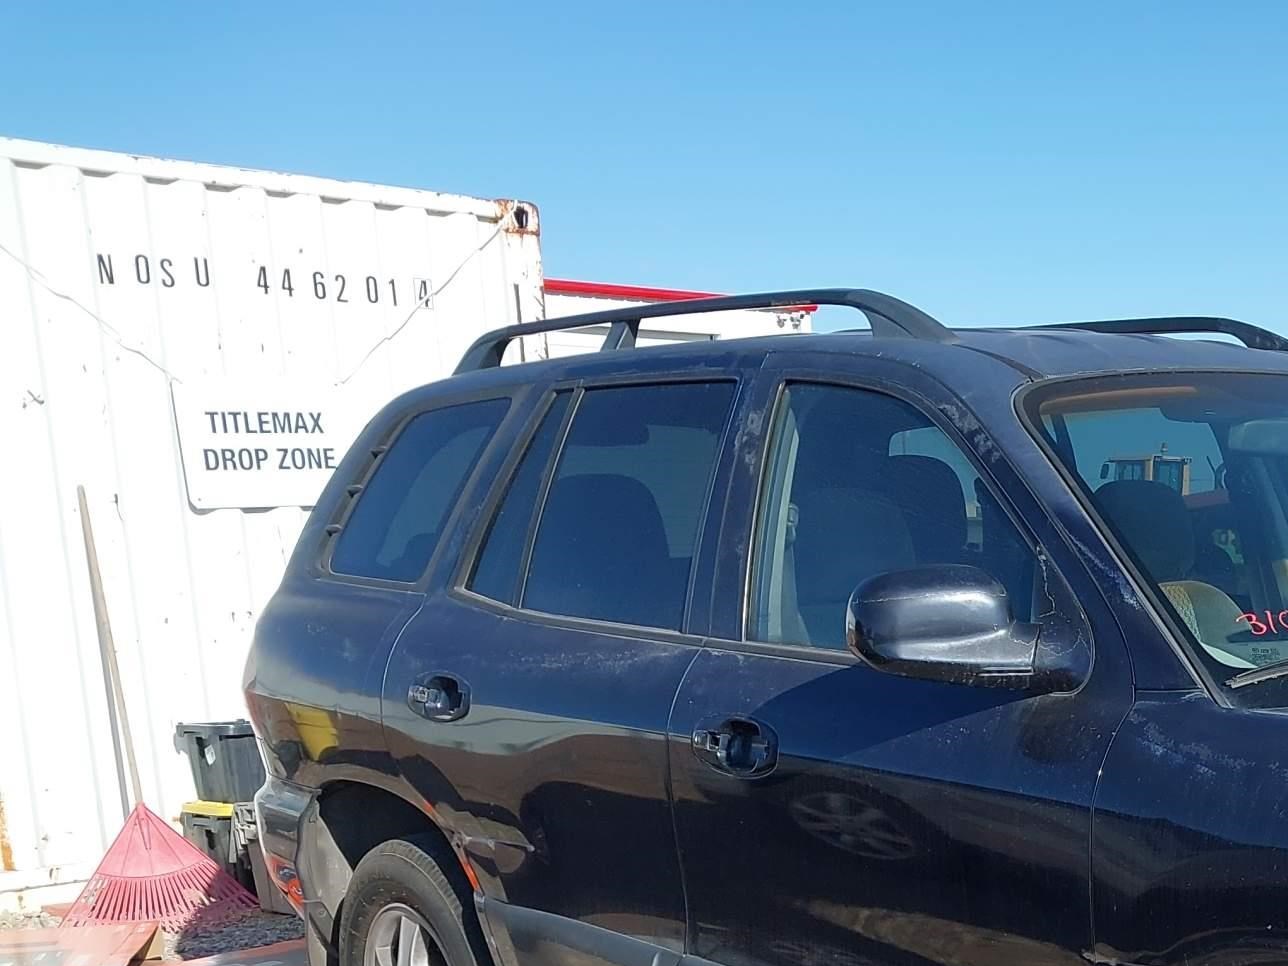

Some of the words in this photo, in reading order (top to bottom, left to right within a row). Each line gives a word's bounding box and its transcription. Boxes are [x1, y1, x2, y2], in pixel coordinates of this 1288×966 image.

[97, 254, 210, 288] NOSU
[205, 411, 325, 434] TITLEMAX
[203, 448, 269, 471] DROP
[276, 447, 337, 469] ZONE
